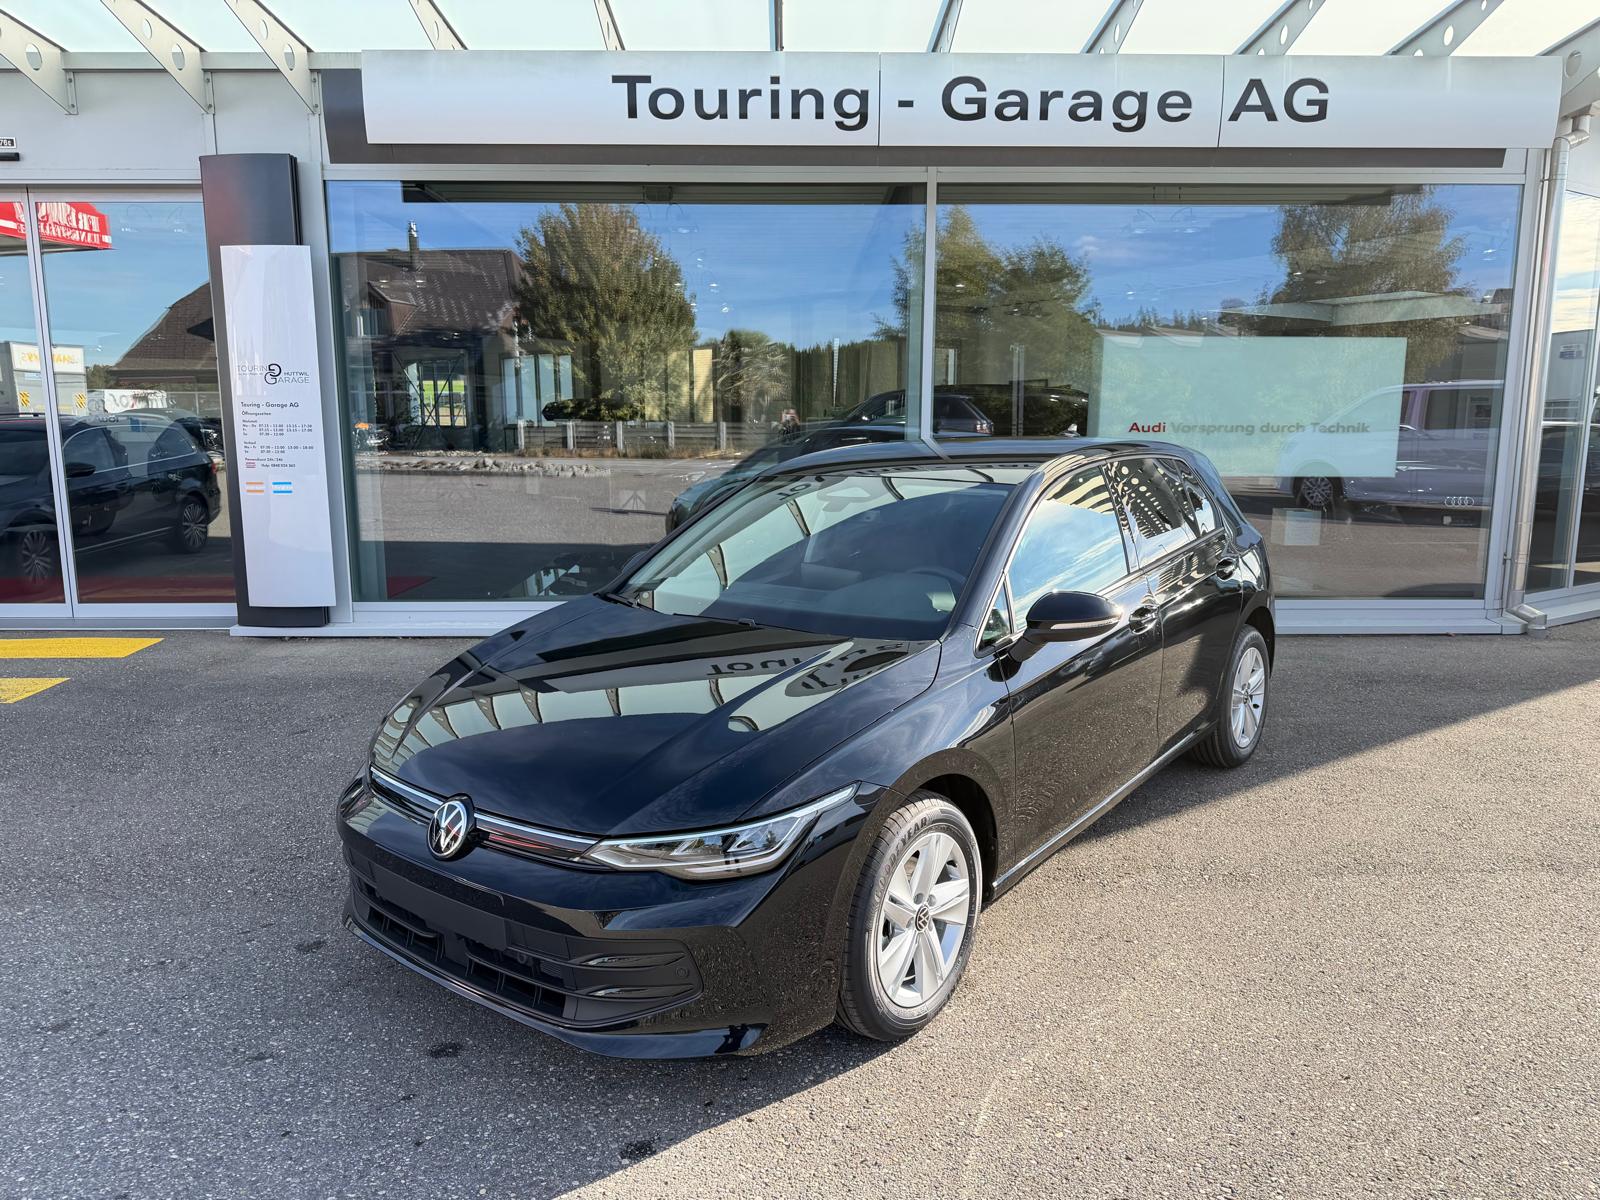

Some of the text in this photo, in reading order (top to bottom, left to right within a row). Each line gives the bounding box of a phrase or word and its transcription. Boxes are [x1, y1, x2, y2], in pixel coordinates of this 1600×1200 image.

[611, 74, 1330, 133] Touring - Garage AG
[240, 401, 261, 409] Touring
[265, 401, 288, 409] Garage
[1128, 422, 1371, 436] Audi Vorsprung durch Technik
